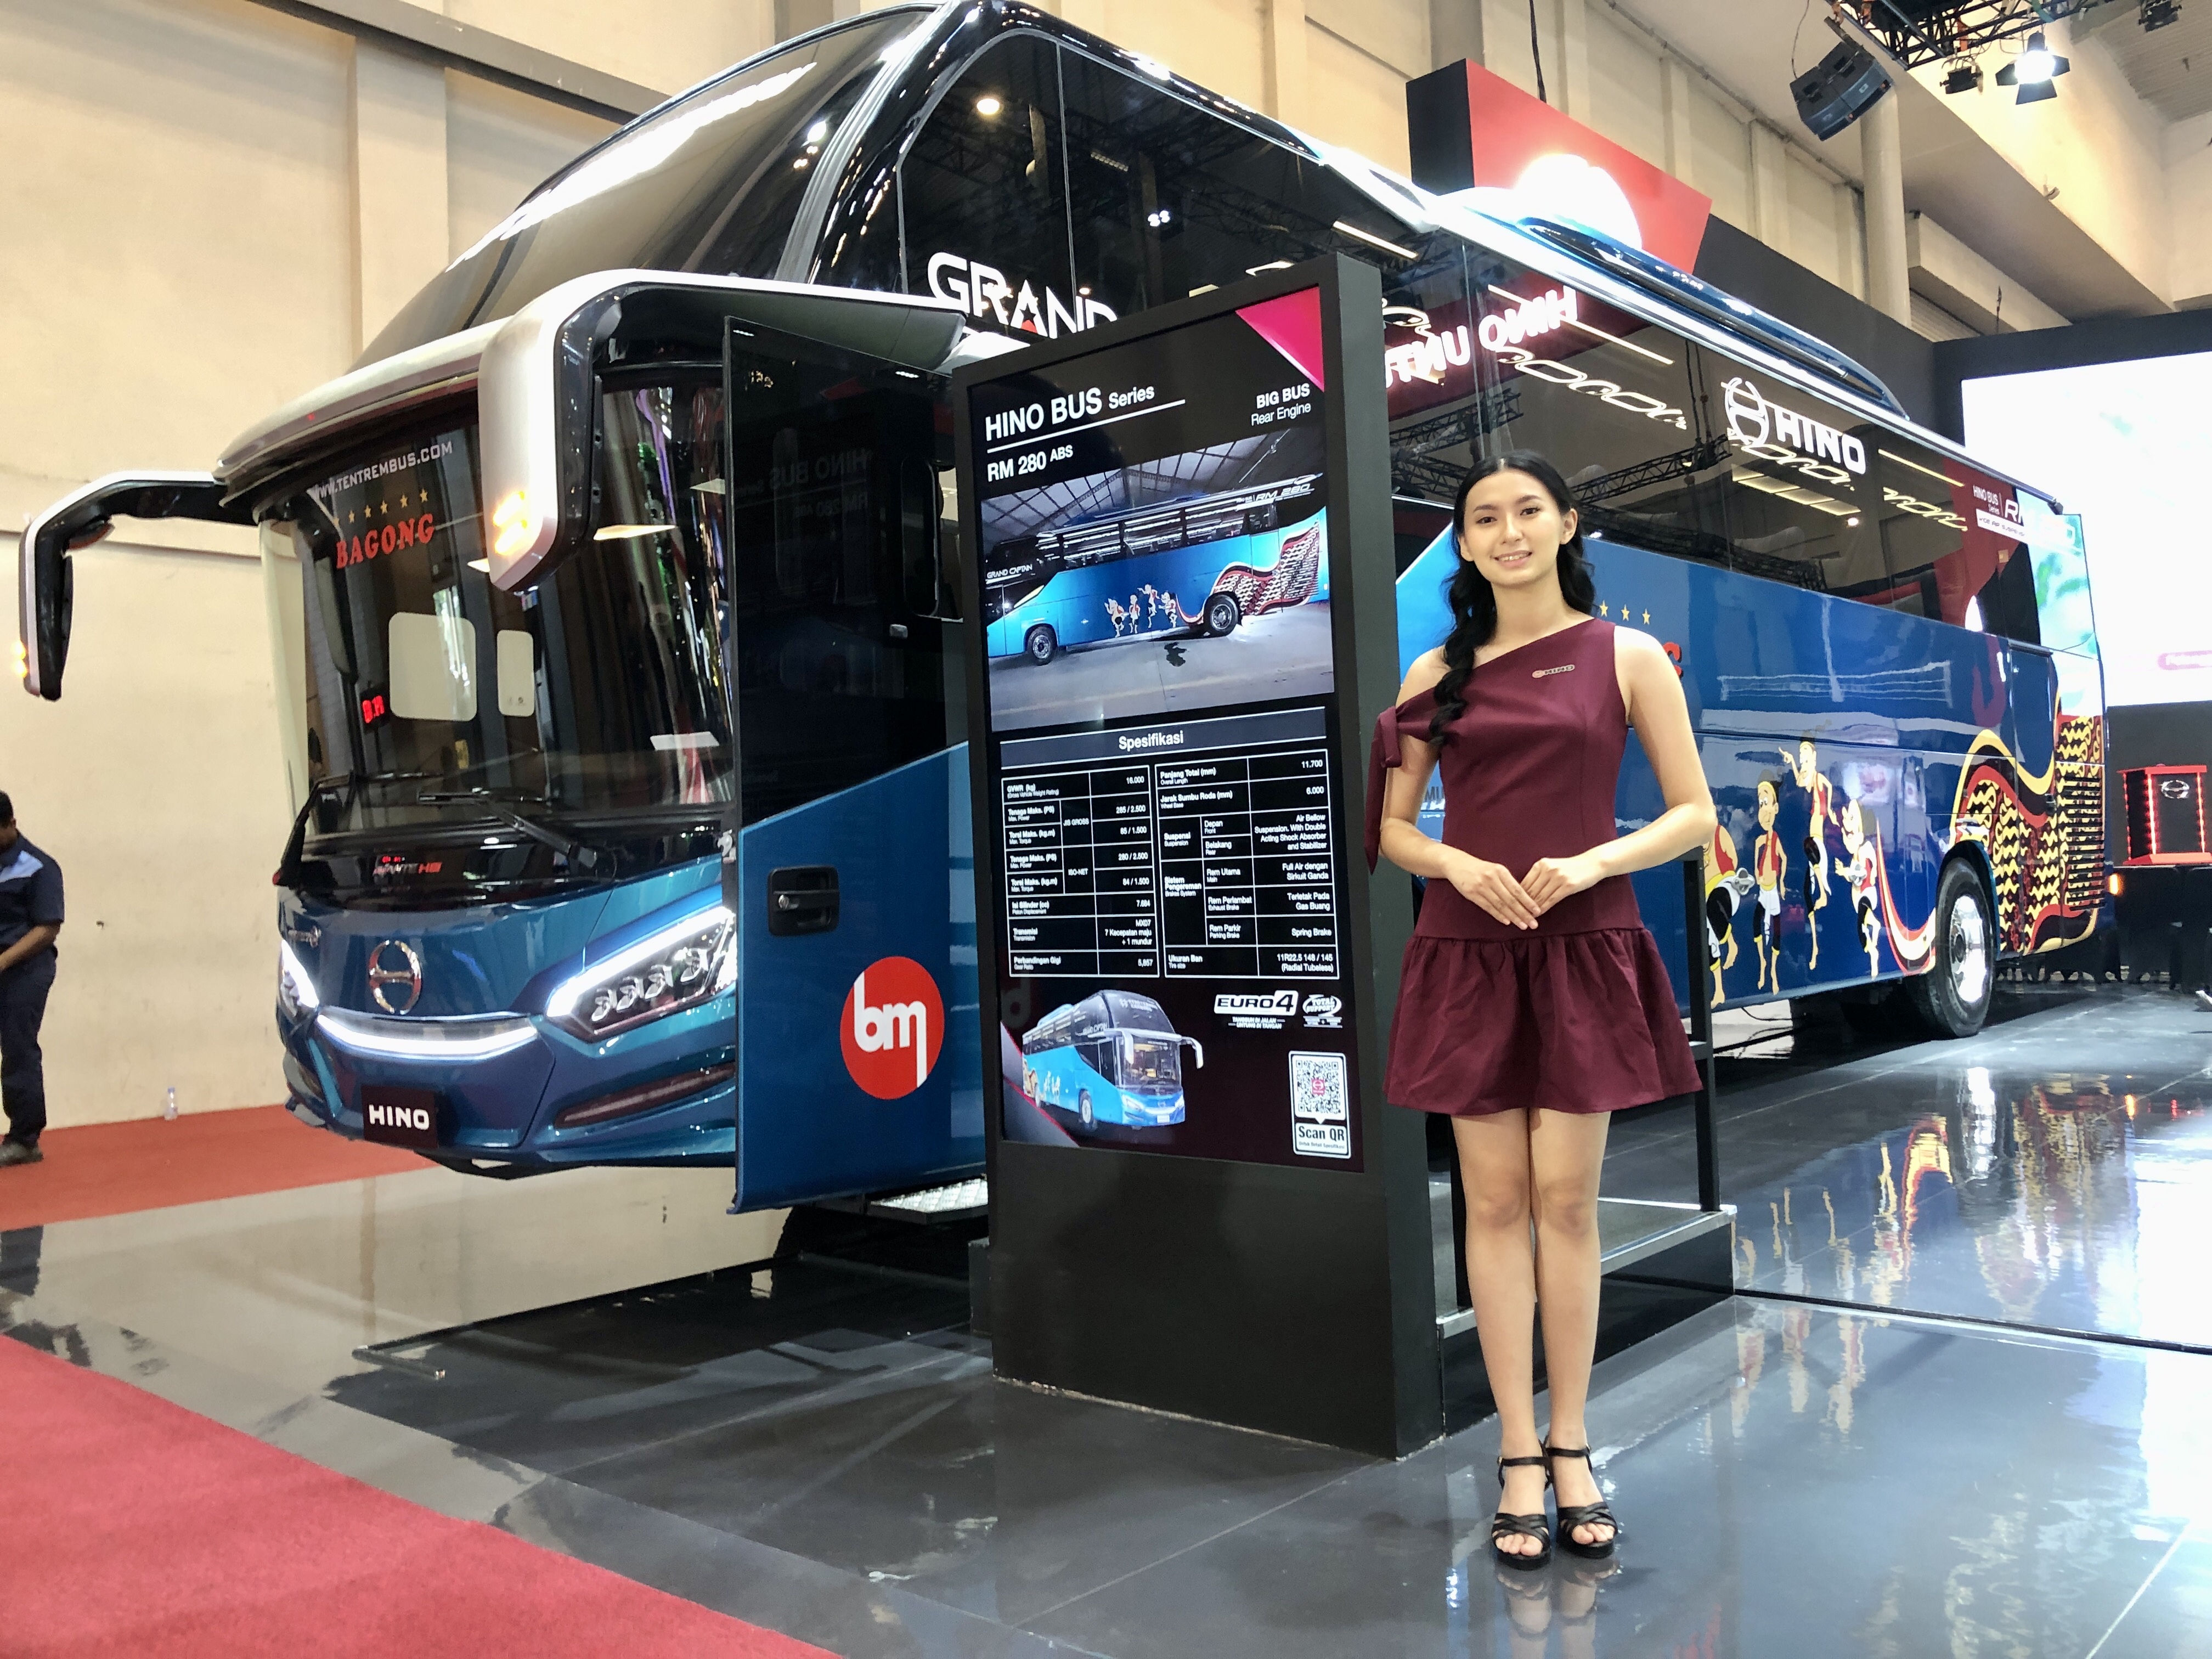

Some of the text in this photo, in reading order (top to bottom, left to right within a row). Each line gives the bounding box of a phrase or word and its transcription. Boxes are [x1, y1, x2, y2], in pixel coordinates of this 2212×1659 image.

[1256, 383, 1310, 409] BIG BUS
[986, 386, 1154, 441] HINO BUS Series
[1251, 403, 1311, 426] Rear Engine
[1774, 405, 1866, 475] HINO
[988, 445, 1073, 482] RM 280 ABS
[1256, 490, 1278, 501] RM
[1281, 483, 1311, 494] 280
[1973, 485, 1999, 505] HINO BUS
[336, 514, 435, 568] BAGONG
[987, 569, 1008, 579] GRAND
[1545, 665, 1573, 675] HINO
[1119, 731, 1184, 752] Spesifikasi
[1160, 767, 1216, 779] Panjang Total (mm)
[1126, 776, 1145, 784] 16.000
[1306, 786, 1324, 794] 6.000
[1160, 790, 1233, 803] Jarak Sumbu Roda (mm)
[1306, 814, 1326, 822] Bellow
[1204, 820, 1223, 828] Depan
[1305, 822, 1327, 831] Double
[1164, 832, 1191, 841] Suspensi
[1260, 832, 1327, 843] Acting Shock Absorber
[1205, 840, 1232, 849] Belakang
[1300, 842, 1327, 850] Stabilizer
[1304, 862, 1328, 871] dengan
[1286, 871, 1329, 881] Sirkuit Ganda
[1165, 883, 1202, 891] Pengereman
[1313, 891, 1330, 900] Pada
[1296, 902, 1330, 911] Gas Buang
[1109, 929, 1137, 938] Kecepatan
[1138, 928, 1152, 938] maju
[1291, 928, 1332, 938] Spring Brake
[1132, 937, 1152, 945] mundur
[1282, 963, 1334, 973] (Radial Tubeless)
[1312, 997, 1334, 1006] TOTAL
[368, 1104, 430, 1130] HINO
[1299, 1126, 1345, 1142] Scan QR
